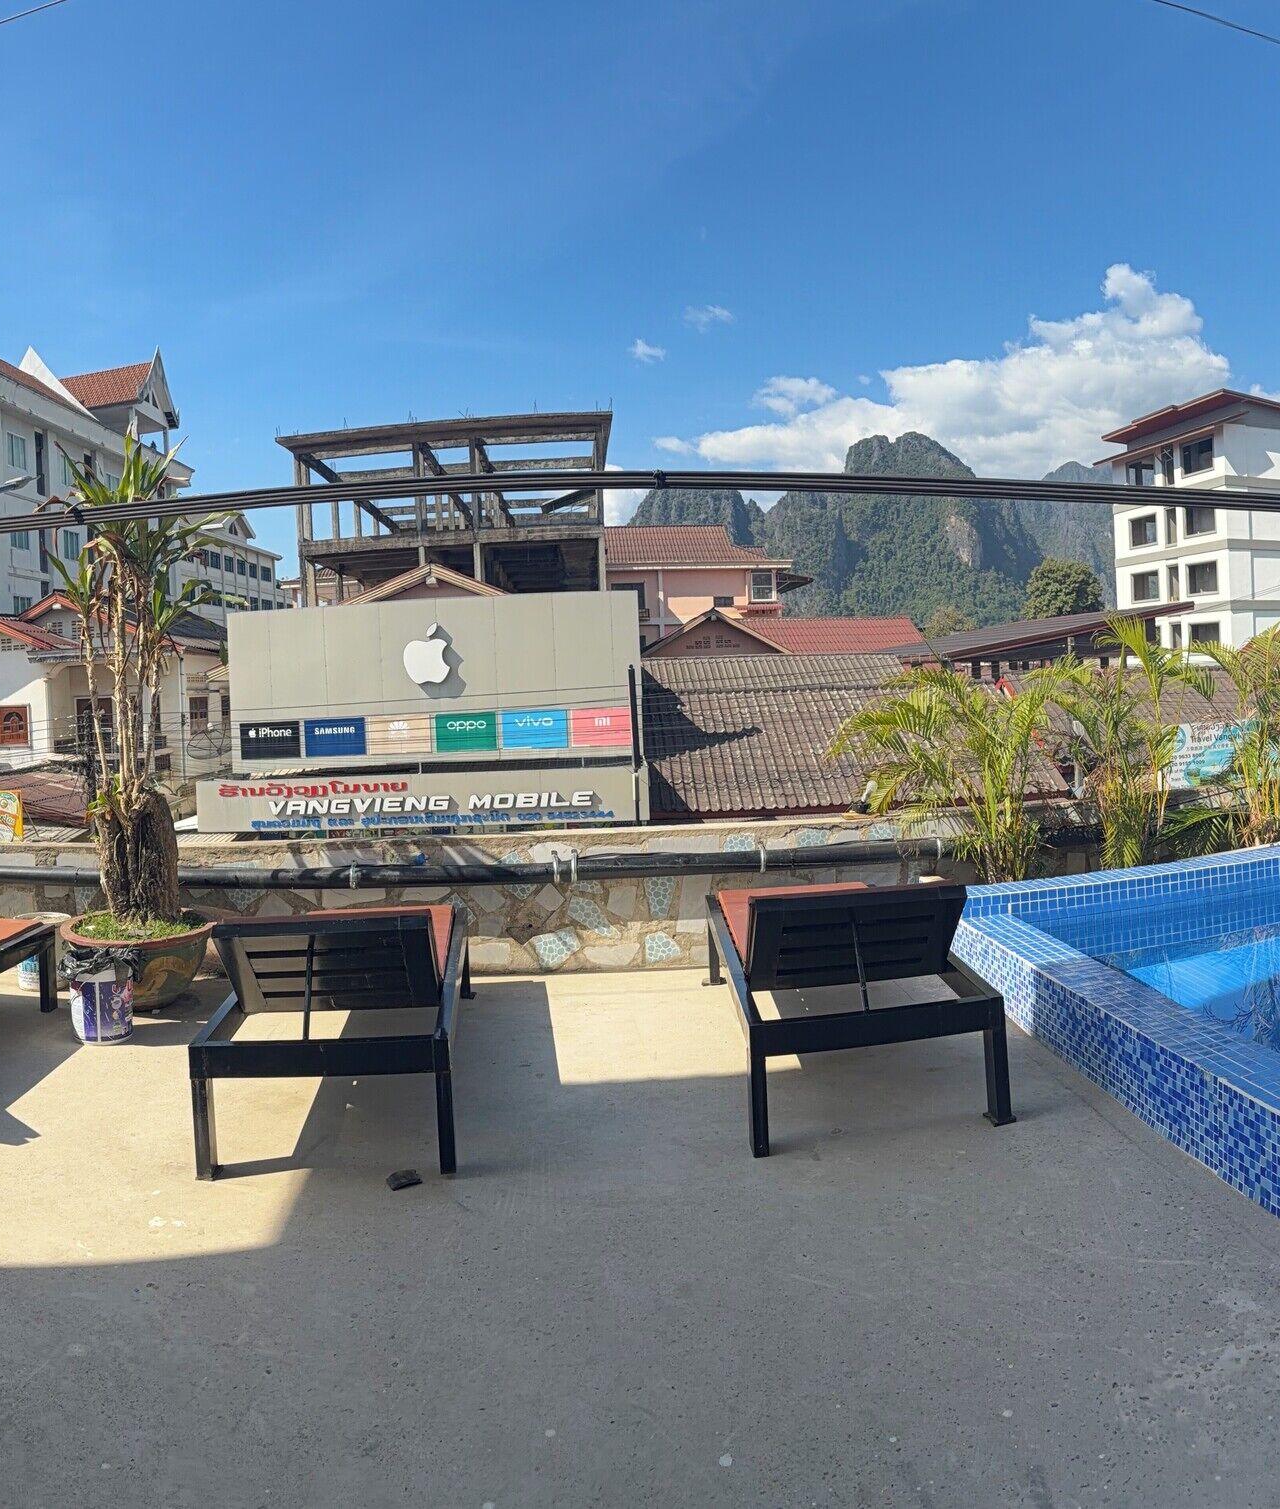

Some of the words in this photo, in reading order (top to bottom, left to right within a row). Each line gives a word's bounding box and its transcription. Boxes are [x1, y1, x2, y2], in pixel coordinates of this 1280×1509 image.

[446, 719, 487, 732] oppo
[514, 715, 554, 727] vivo
[258, 727, 292, 738] iPhone
[314, 726, 356, 735] SAMSUNG
[1191, 735, 1212, 743] Travel
[268, 795, 451, 816] VANGVIENG
[468, 790, 595, 810] MOBILE
[517, 811, 543, 821] 020
